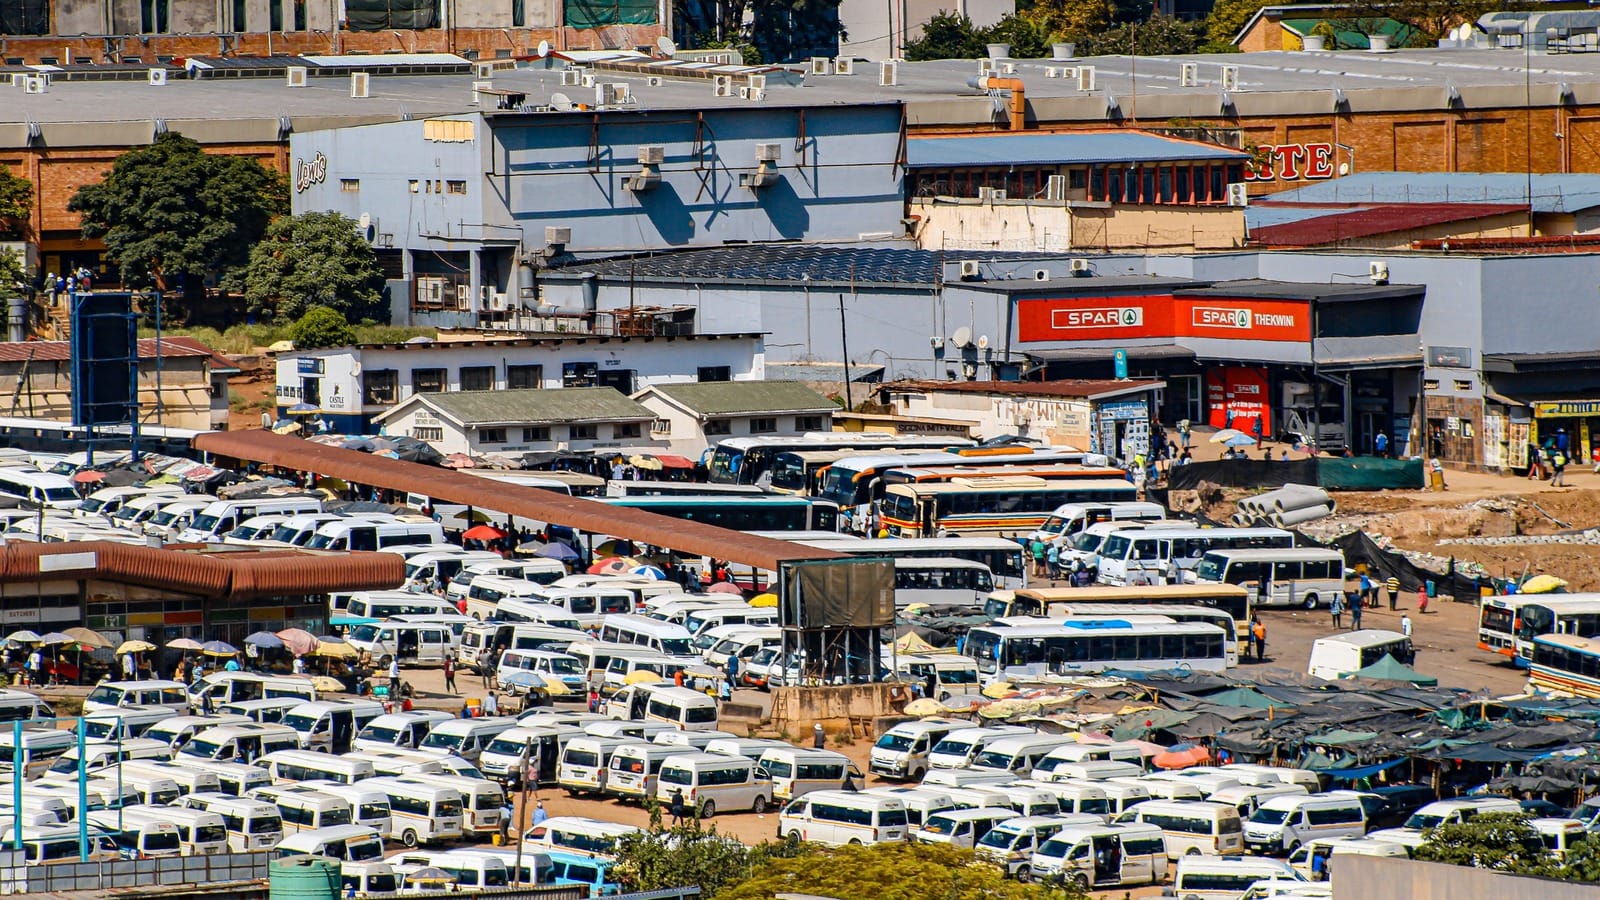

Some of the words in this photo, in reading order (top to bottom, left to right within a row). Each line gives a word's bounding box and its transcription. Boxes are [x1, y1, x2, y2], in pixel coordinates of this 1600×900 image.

[1244, 142, 1334, 181] ITE
[296, 151, 327, 193] Lewis
[1068, 311, 1119, 325] SPAR
[1202, 311, 1236, 324] SPAR
[1254, 313, 1294, 327] THEKWINI
[329, 396, 345, 404] CASTLE
